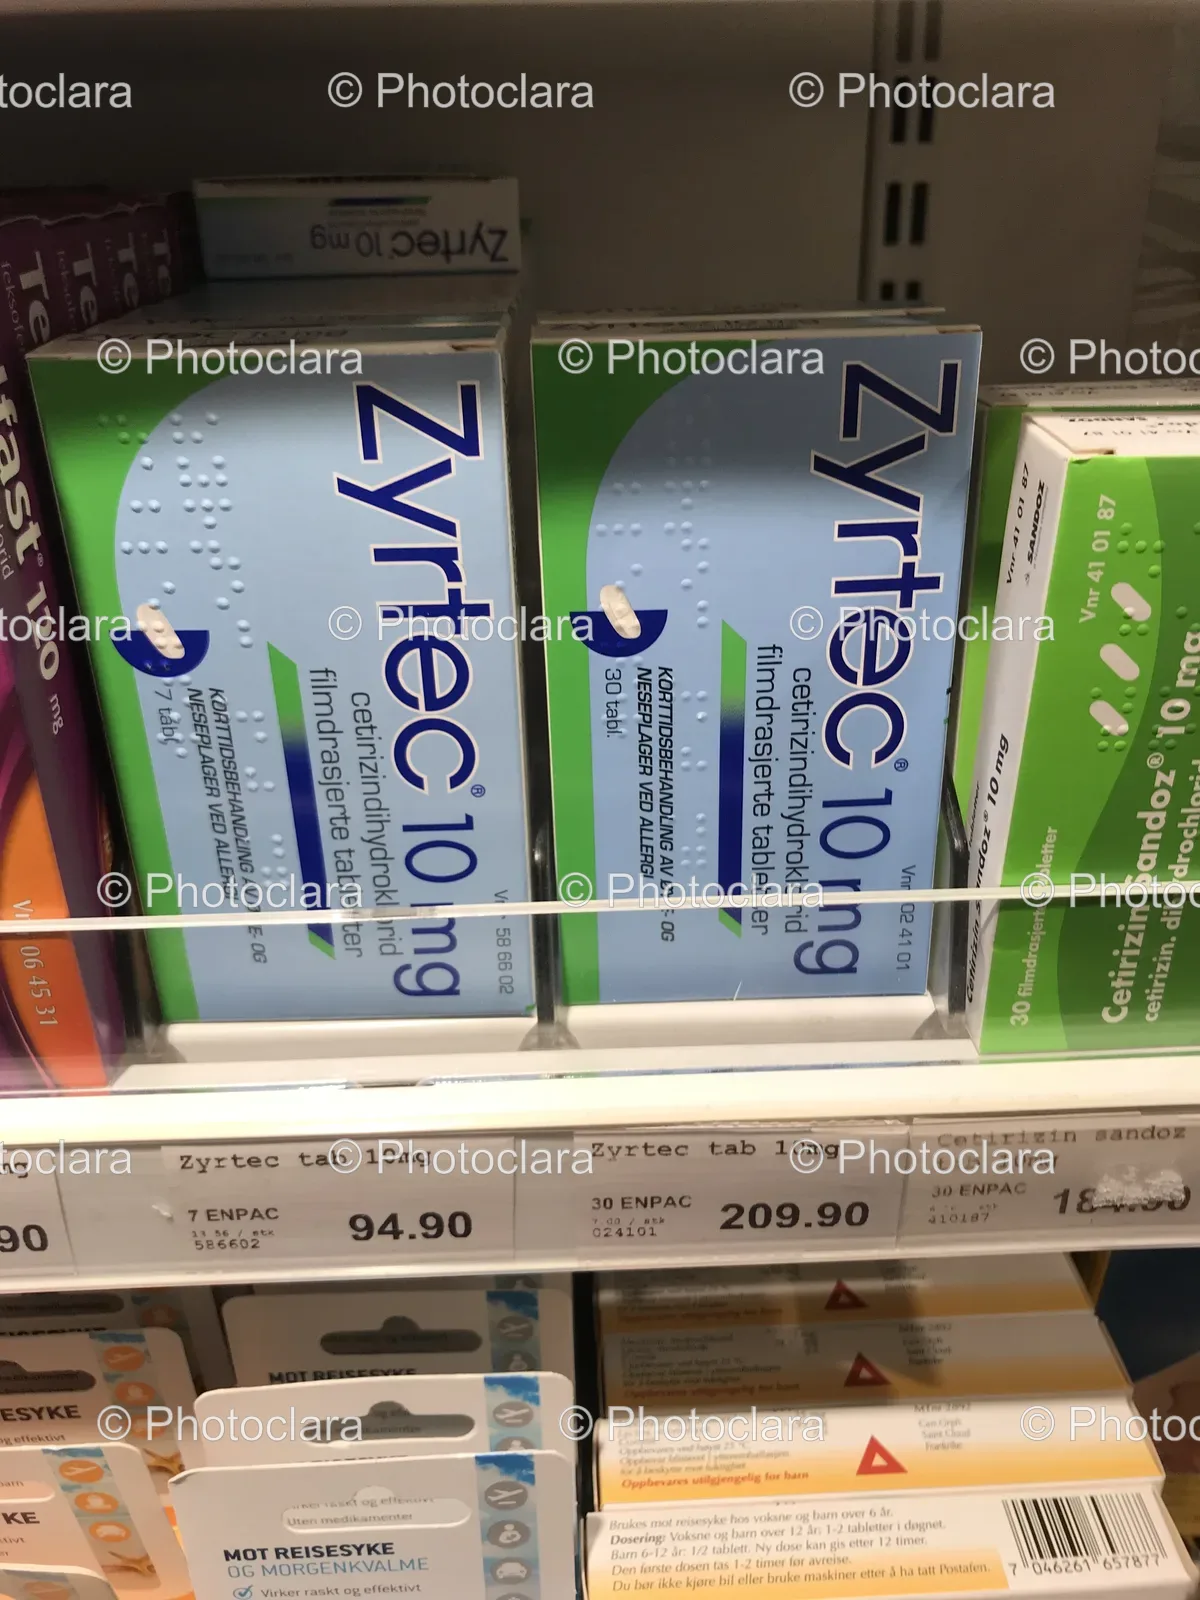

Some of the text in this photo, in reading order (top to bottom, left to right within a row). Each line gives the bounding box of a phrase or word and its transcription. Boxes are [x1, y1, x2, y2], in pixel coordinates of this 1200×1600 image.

[310, 224, 350, 250] mg
[355, 232, 382, 258] 10
[1027, 479, 1045, 564] SANDOZ
[1079, 493, 1117, 624] Vnr 41 01 87
[50, 693, 65, 736] mg
[605, 668, 623, 739] 30 tabl.
[748, 643, 783, 818] filmdrasjerte
[187, 687, 220, 798] NESEPLAGER
[207, 802, 228, 834] VED
[309, 667, 352, 842] filmdrasjerte
[637, 667, 655, 880] NESEPLAGER VED ALLERGI
[657, 666, 675, 942] KORTTIDSBEHANDLING AV OG
[209, 687, 268, 964] KORTTIDSBEHANDLING OG
[819, 787, 894, 860] 10
[402, 813, 478, 883] 10
[965, 733, 1010, 1003] Cetirizin 10 mg
[1102, 905, 1150, 1025] Cetirizin
[1156, 698, 1191, 739] 10
[899, 903, 914, 924] 02
[495, 927, 511, 947] 58
[793, 878, 865, 976] mg
[897, 928, 913, 948] 41
[20, 945, 44, 969] 06
[393, 902, 462, 998] mg
[497, 951, 512, 971] 66
[896, 952, 911, 971] 01
[29, 975, 52, 999] 45
[499, 974, 514, 995] 02
[1145, 936, 1177, 1023] cetirizin.
[36, 1005, 59, 1025] 31
[1010, 1000, 1031, 1028] 30
[937, 1125, 1187, 1148] Cetirizin sandoz
[179, 1153, 280, 1174] Zyrtec
[298, 1150, 347, 1168] tab
[591, 1141, 689, 1162] Zyrtec
[708, 1140, 756, 1156] tab
[931, 1182, 1027, 1199] 30 ENPAC
[188, 1206, 280, 1223] 7 ENPAC
[591, 1195, 692, 1211] 30 ENPAC
[348, 1210, 473, 1242] 94.90
[719, 1201, 870, 1231] 209.90
[194, 1237, 261, 1251] 586602
[592, 1226, 657, 1238] 024101
[320, 1513, 413, 1526] medikamenter
[650, 1517, 673, 1529] mot
[812, 1509, 839, 1521] barn
[841, 1511, 866, 1519] over
[670, 1530, 711, 1542] Voksne
[730, 1528, 757, 1539] barn
[760, 1530, 786, 1538] over
[847, 1522, 894, 1533] tabletter
[224, 1542, 395, 1562] MOT REISESYKE
[611, 1549, 638, 1560] Barn
[775, 1541, 803, 1552] dose
[805, 1540, 827, 1551] kan
[830, 1539, 846, 1553] gis
[849, 1537, 875, 1549] etter
[228, 1557, 430, 1579] OG MORGENKVALME
[612, 1564, 637, 1575] Den
[675, 1560, 710, 1572] dosen
[713, 1559, 731, 1571] tas
[755, 1557, 786, 1568] timer
[1008, 1553, 1160, 1576] 7 046261 657877
[657, 1565, 937, 1591] ikke kjøre bil eller bruke maskiner etter tatt
[261, 1582, 422, 1599] Virker raskt og effektivt
